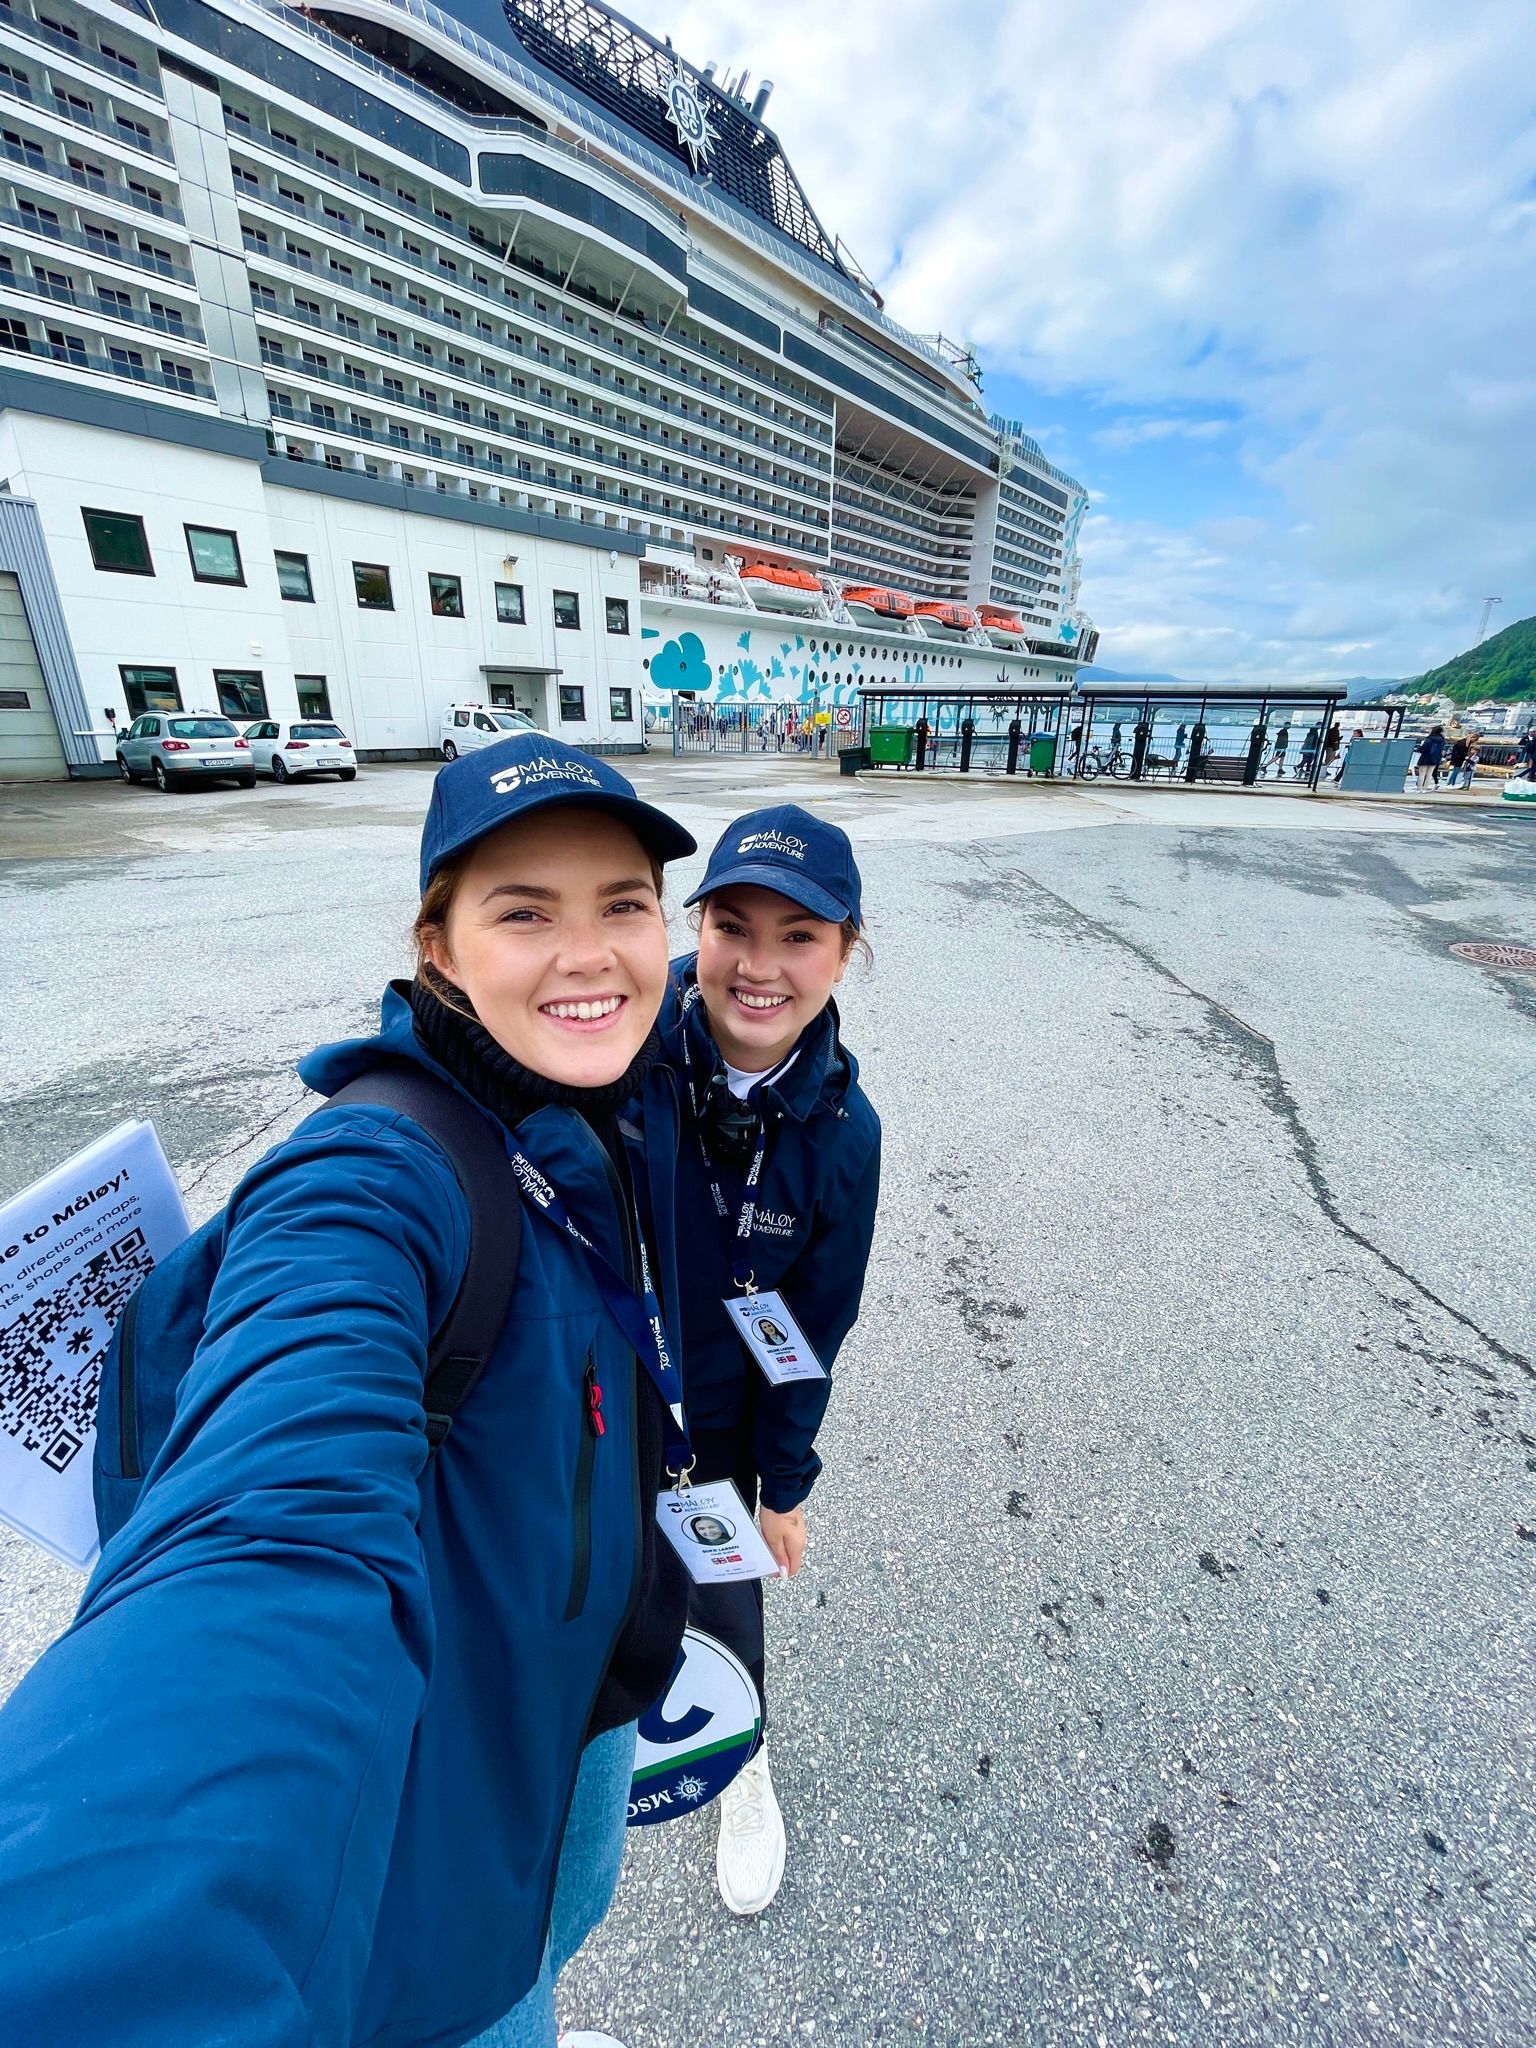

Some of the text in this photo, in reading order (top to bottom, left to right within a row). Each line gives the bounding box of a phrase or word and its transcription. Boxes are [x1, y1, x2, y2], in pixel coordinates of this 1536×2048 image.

[518, 756, 593, 777] MÅLØY
[525, 770, 603, 788] ADVENTURE
[752, 841, 805, 860] ADVENTURE
[756, 829, 808, 851] MÅLØY
[513, 1152, 548, 1187] ADVENTURE
[23, 1225, 49, 1244] to
[52, 1169, 129, 1226] Måløy!
[17, 1226, 94, 1280] directions,
[97, 1195, 140, 1225] maps,
[26, 1255, 71, 1291] shops
[74, 1232, 103, 1256] and
[106, 1207, 142, 1235] more
[626, 1789, 674, 1818] MSC
